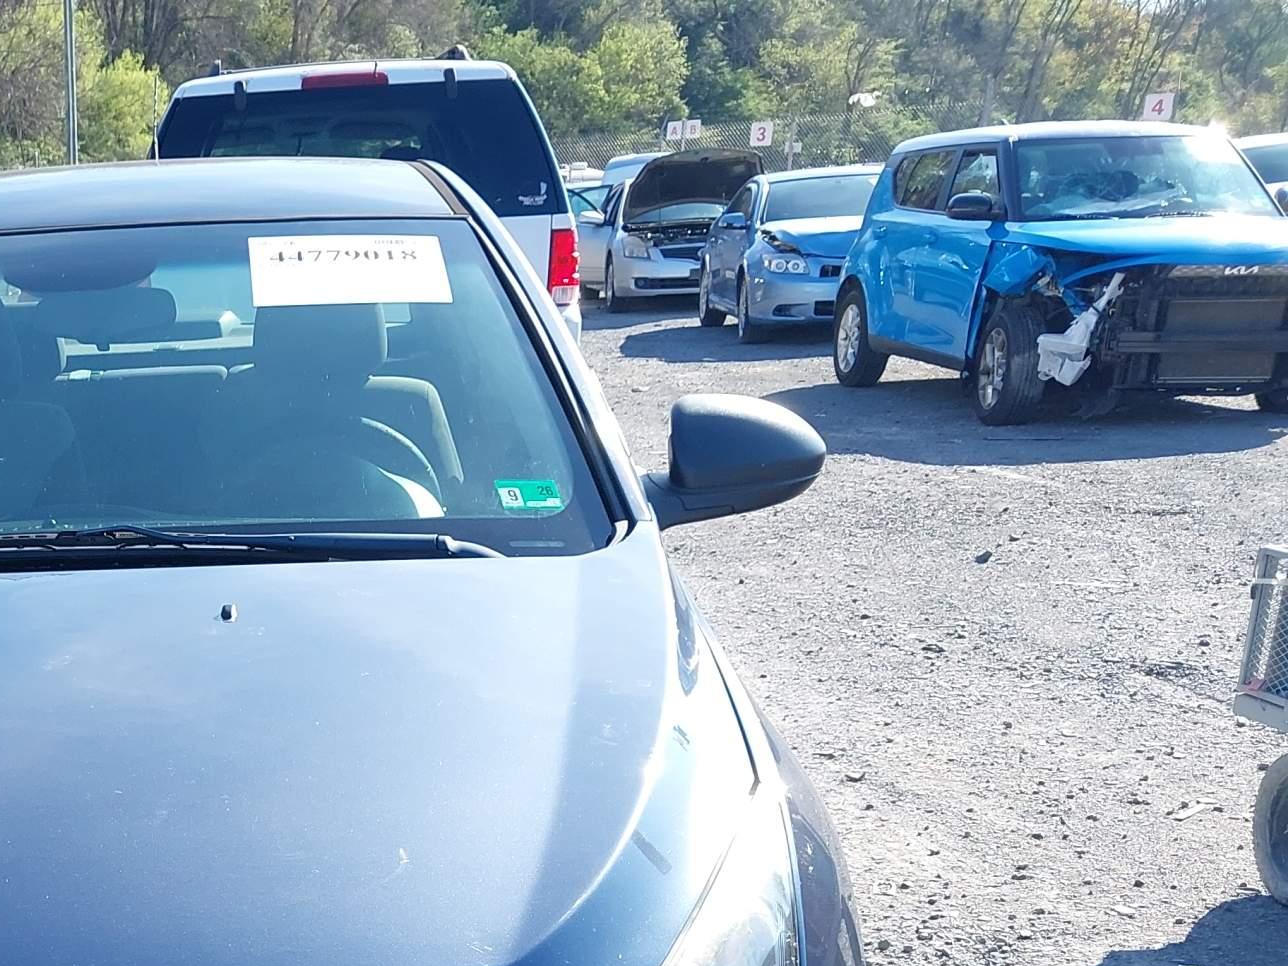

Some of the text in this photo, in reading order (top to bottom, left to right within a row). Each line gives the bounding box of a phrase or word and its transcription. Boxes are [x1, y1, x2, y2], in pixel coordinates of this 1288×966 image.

[1151, 99, 1165, 115] 4
[756, 126, 767, 142] 3
[269, 250, 417, 262] 44779018
[507, 489, 519, 501] 9
[537, 485, 553, 496] 26
